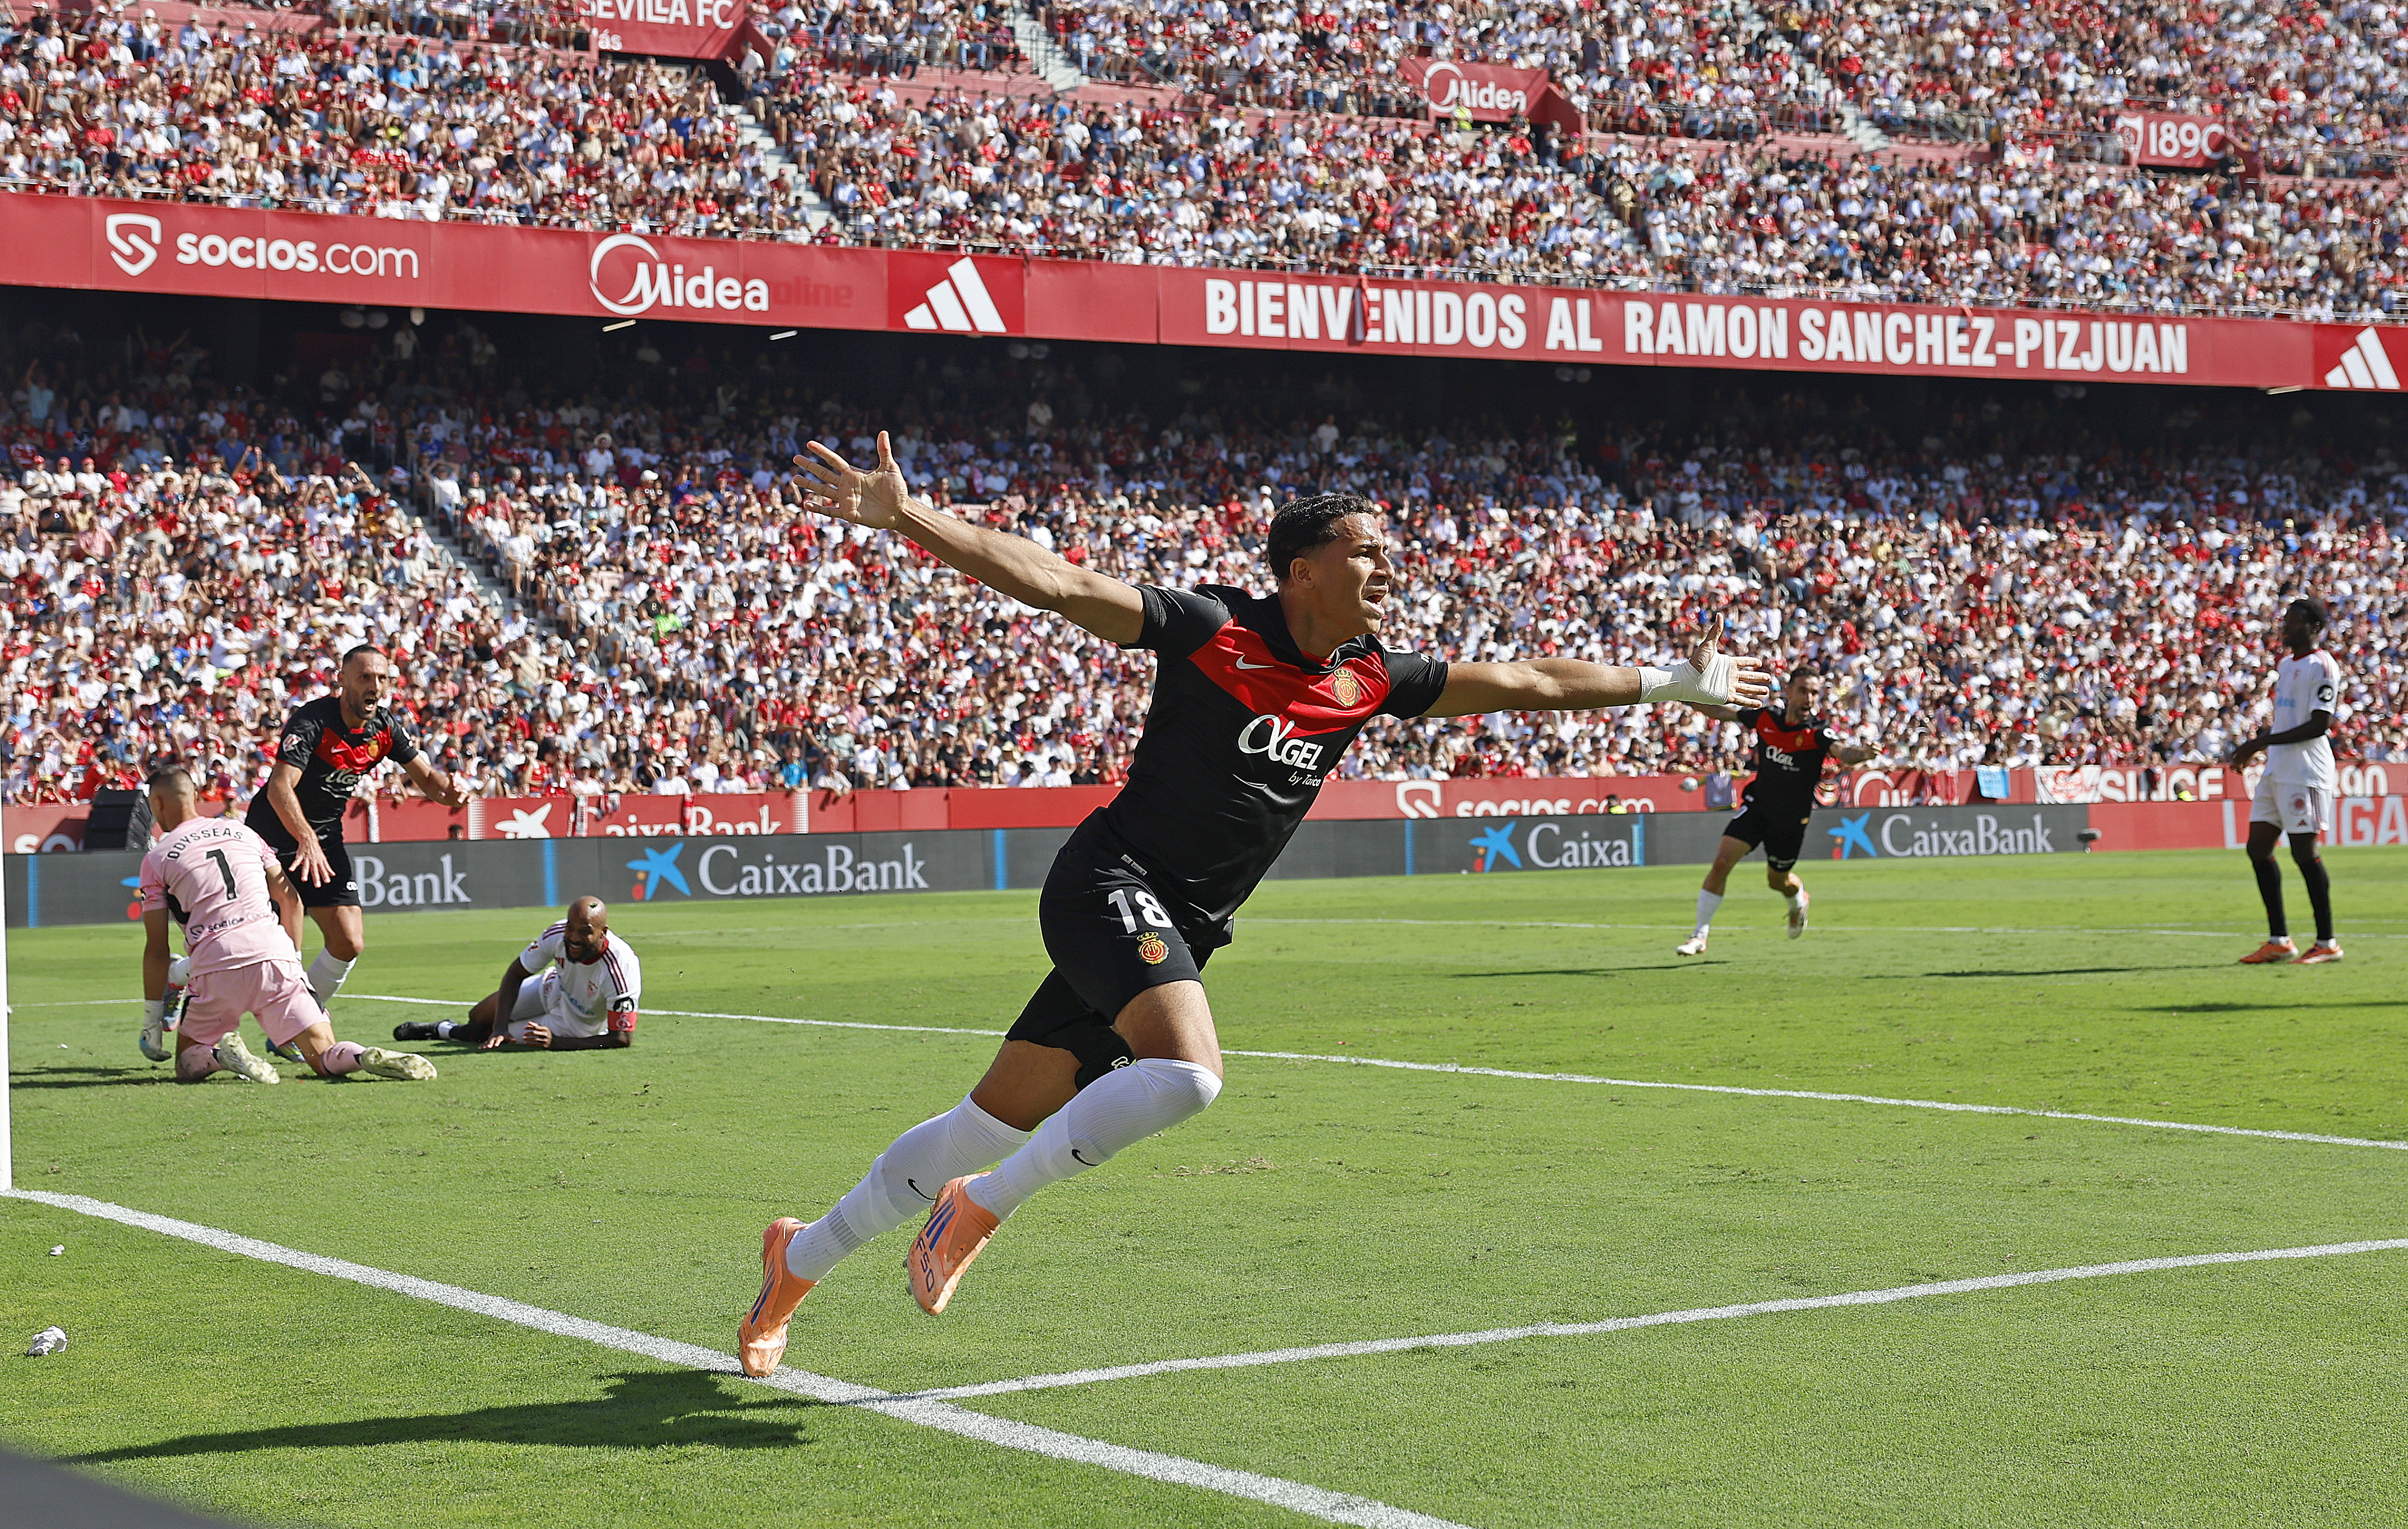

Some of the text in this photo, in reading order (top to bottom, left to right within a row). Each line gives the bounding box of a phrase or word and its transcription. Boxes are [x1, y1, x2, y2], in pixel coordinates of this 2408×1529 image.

[697, 0, 734, 29] FC
[1425, 70, 1527, 113] Midea
[589, 245, 769, 315] Midea
[1205, 278, 2188, 374] BIENVENIDOS AL RAMON SANCHEZ-PIZJUAN
[1288, 770, 1303, 786] by
[167, 828, 243, 860] ODYSSEAS
[1881, 813, 2055, 857] CaixaBank
[205, 848, 238, 902] 1
[698, 842, 929, 896] CaixaBank
[1108, 889, 1174, 934] 18
[915, 1238, 935, 1293] F50
